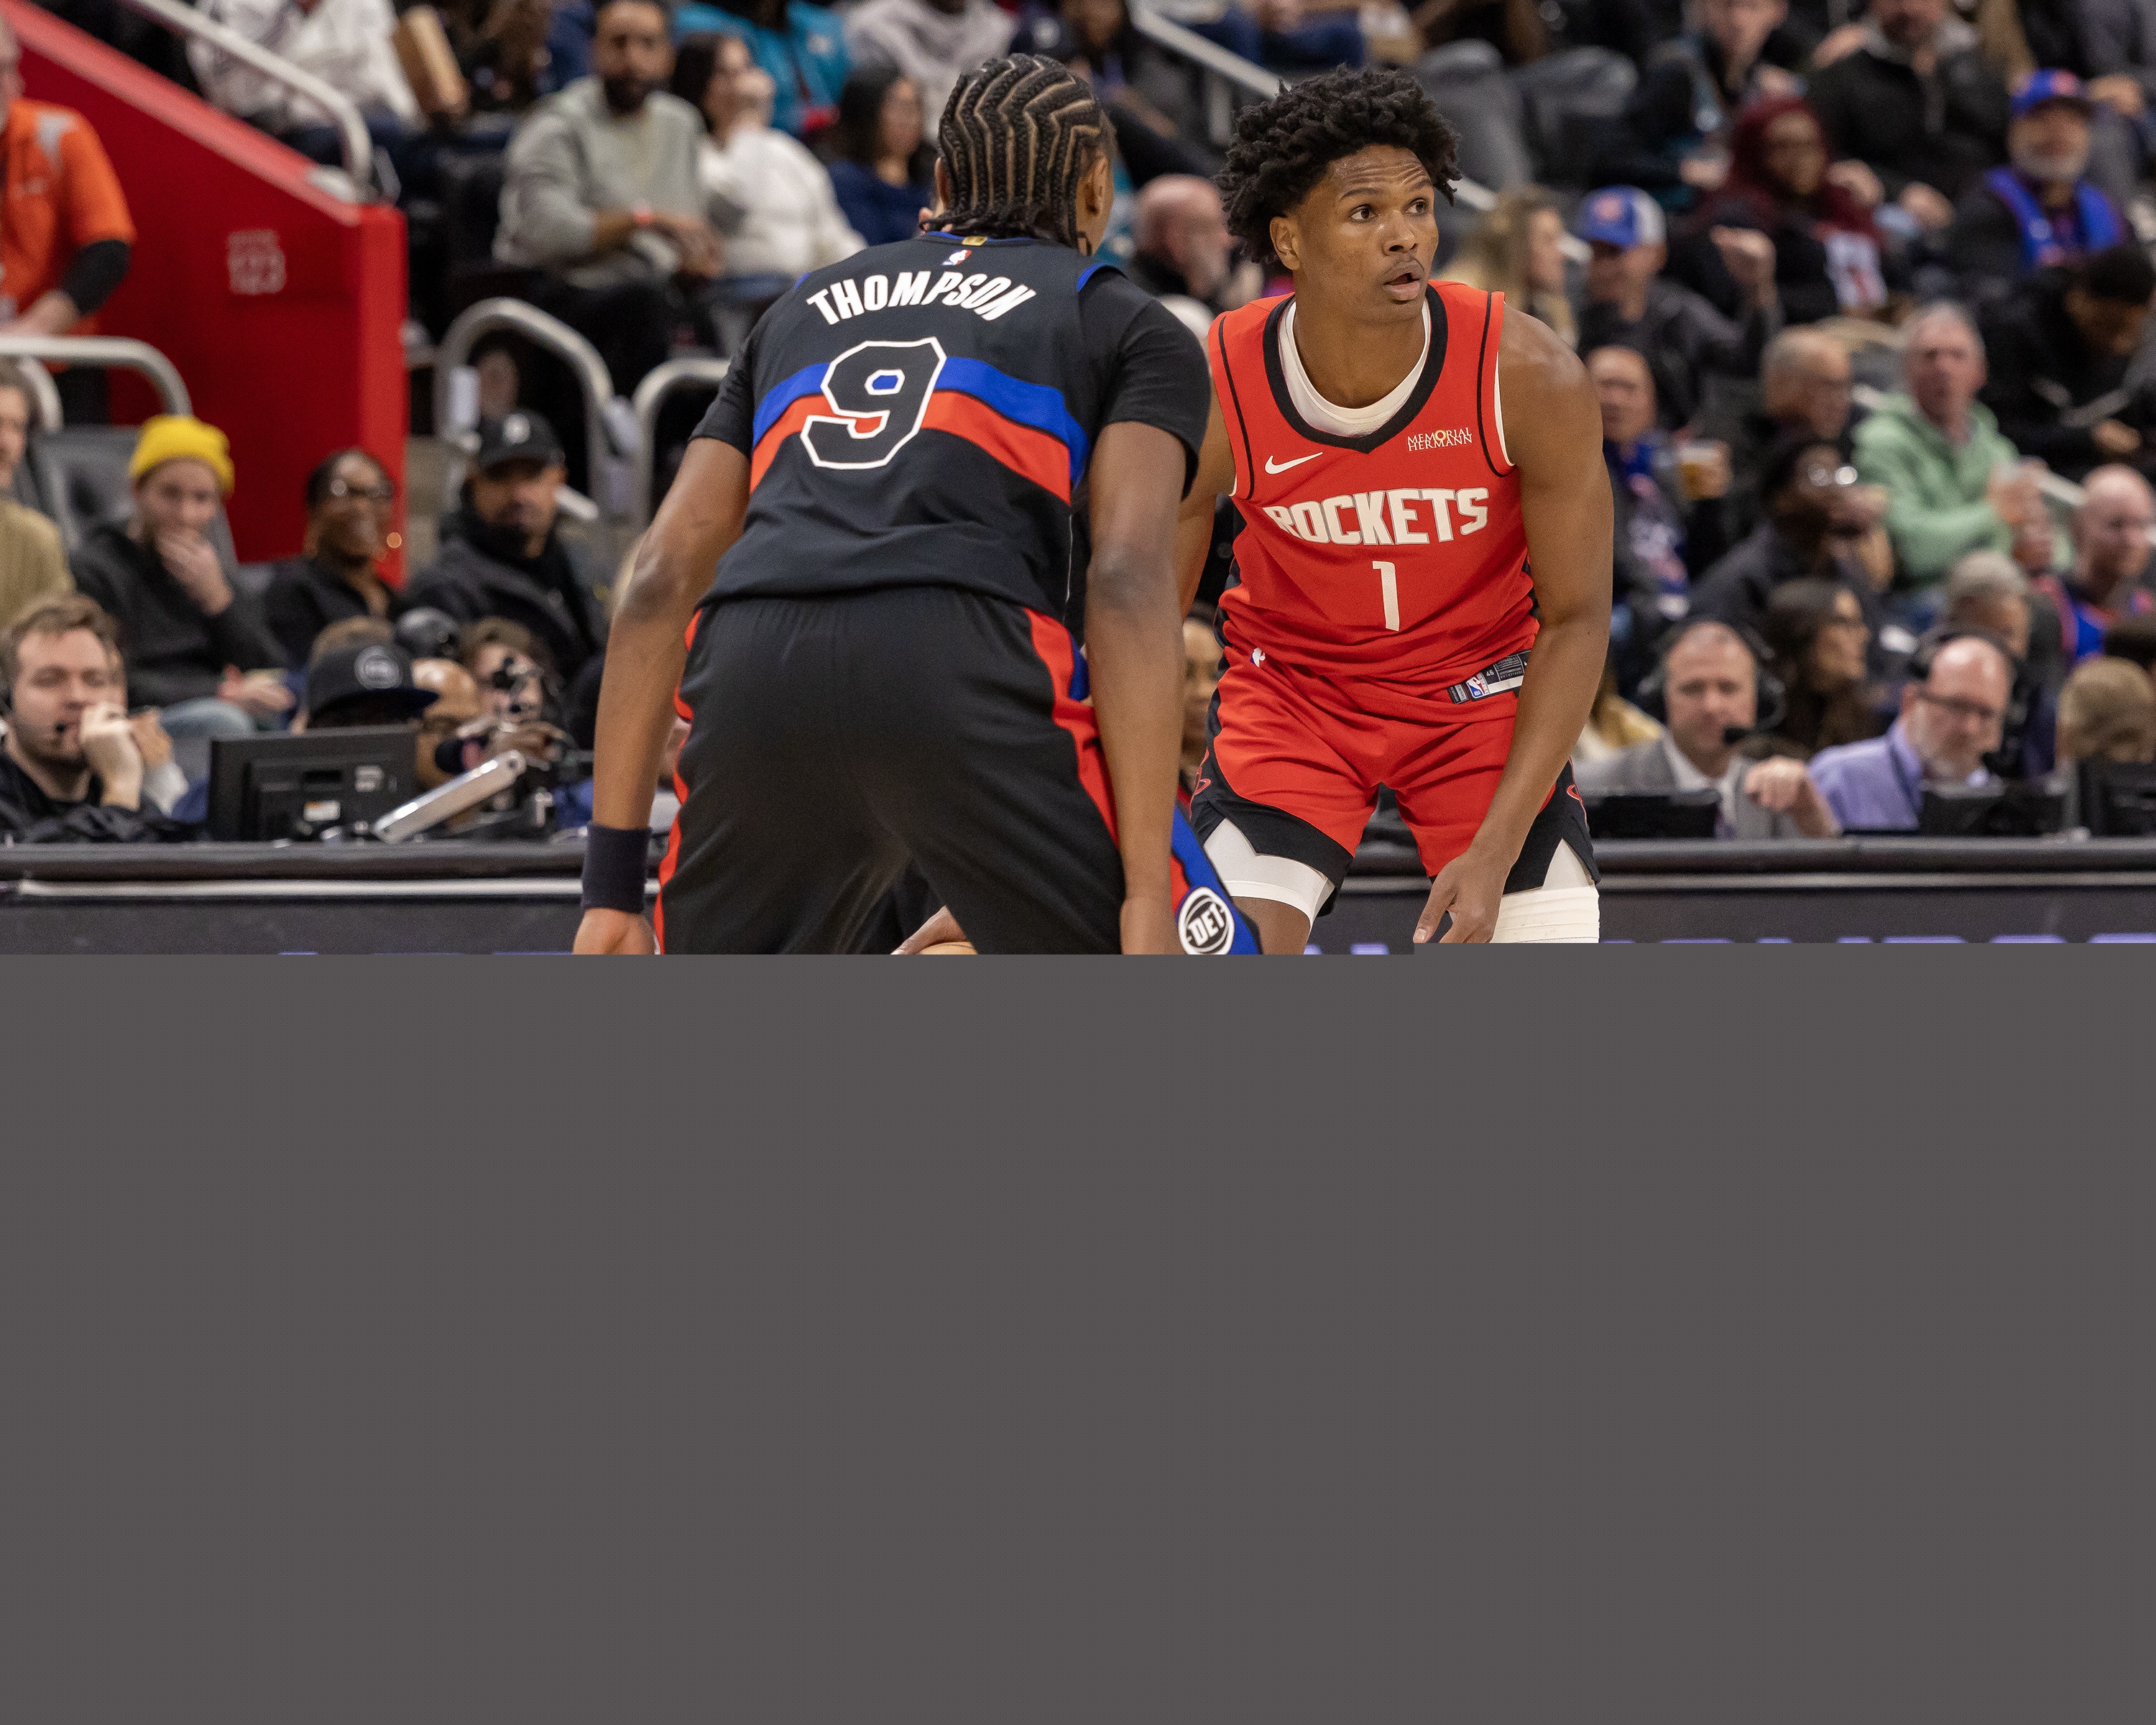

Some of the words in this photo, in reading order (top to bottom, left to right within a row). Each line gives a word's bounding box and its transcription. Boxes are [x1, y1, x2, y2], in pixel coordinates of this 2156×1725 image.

[806, 271, 1037, 325] THOMPSON
[800, 336, 947, 469] 9
[1407, 427, 1472, 444] MEMORIAL
[1408, 435, 1472, 451] HERMANN
[1263, 487, 1489, 546] ROCKETS
[1372, 561, 1400, 632] 1
[1187, 902, 1225, 947] DET
